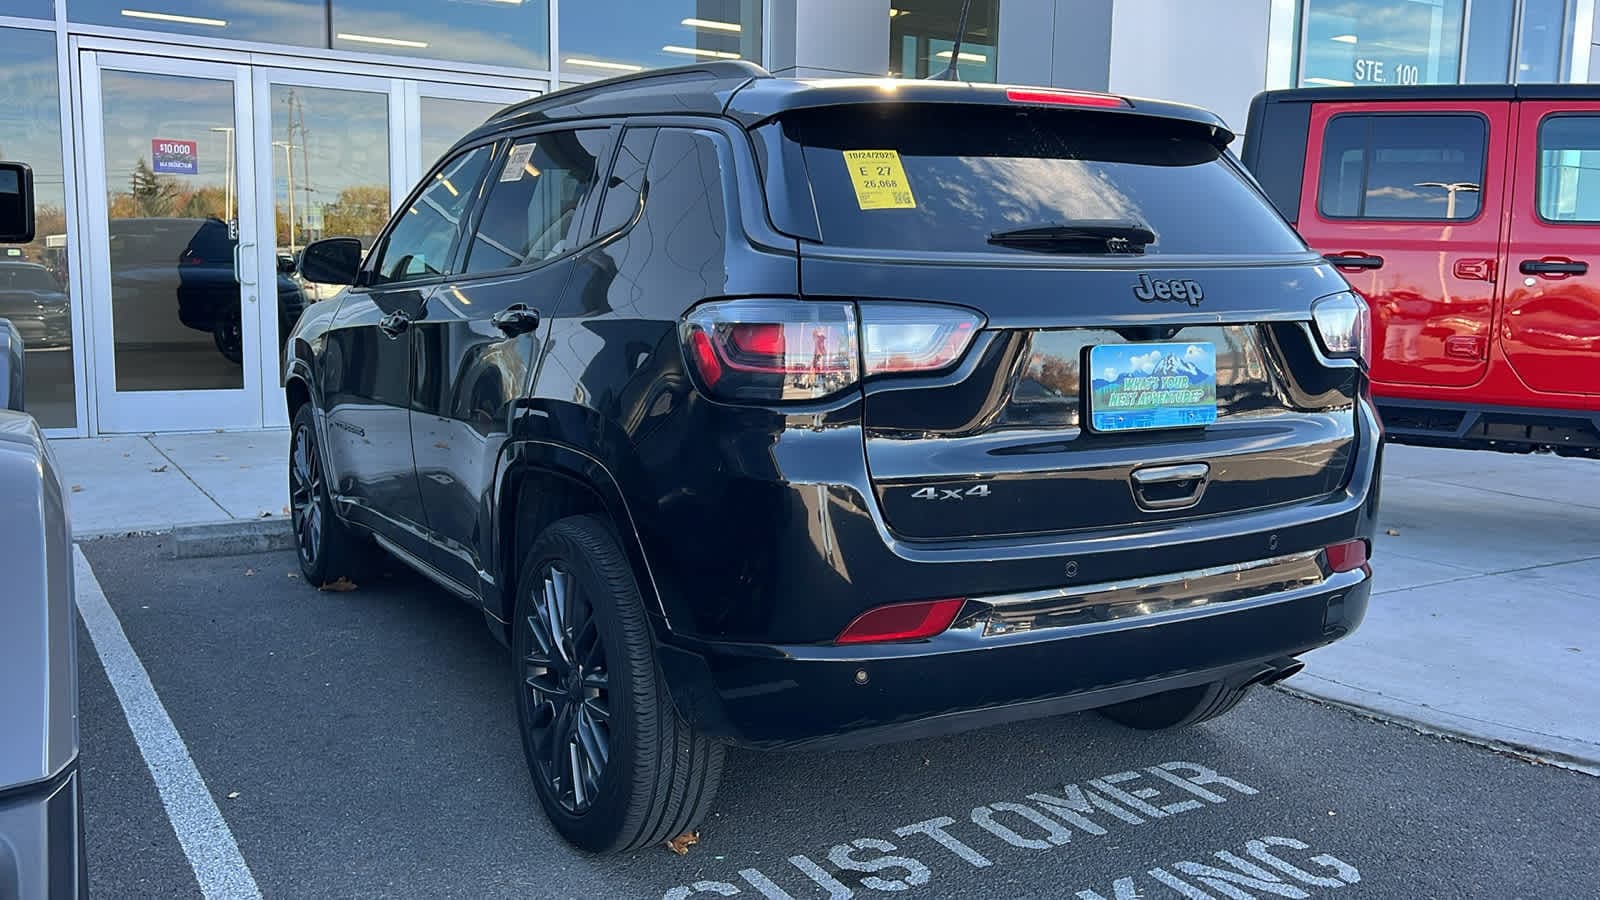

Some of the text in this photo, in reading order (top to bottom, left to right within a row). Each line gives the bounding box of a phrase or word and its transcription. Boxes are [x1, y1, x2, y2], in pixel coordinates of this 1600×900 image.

[1355, 59, 1418, 85] STE. 100
[860, 166, 892, 176] E 27
[1132, 273, 1205, 307] Jeep
[1161, 375, 1190, 389] YOUR
[1137, 389, 1205, 405] ADVENTURE?
[911, 484, 992, 501] 4x4
